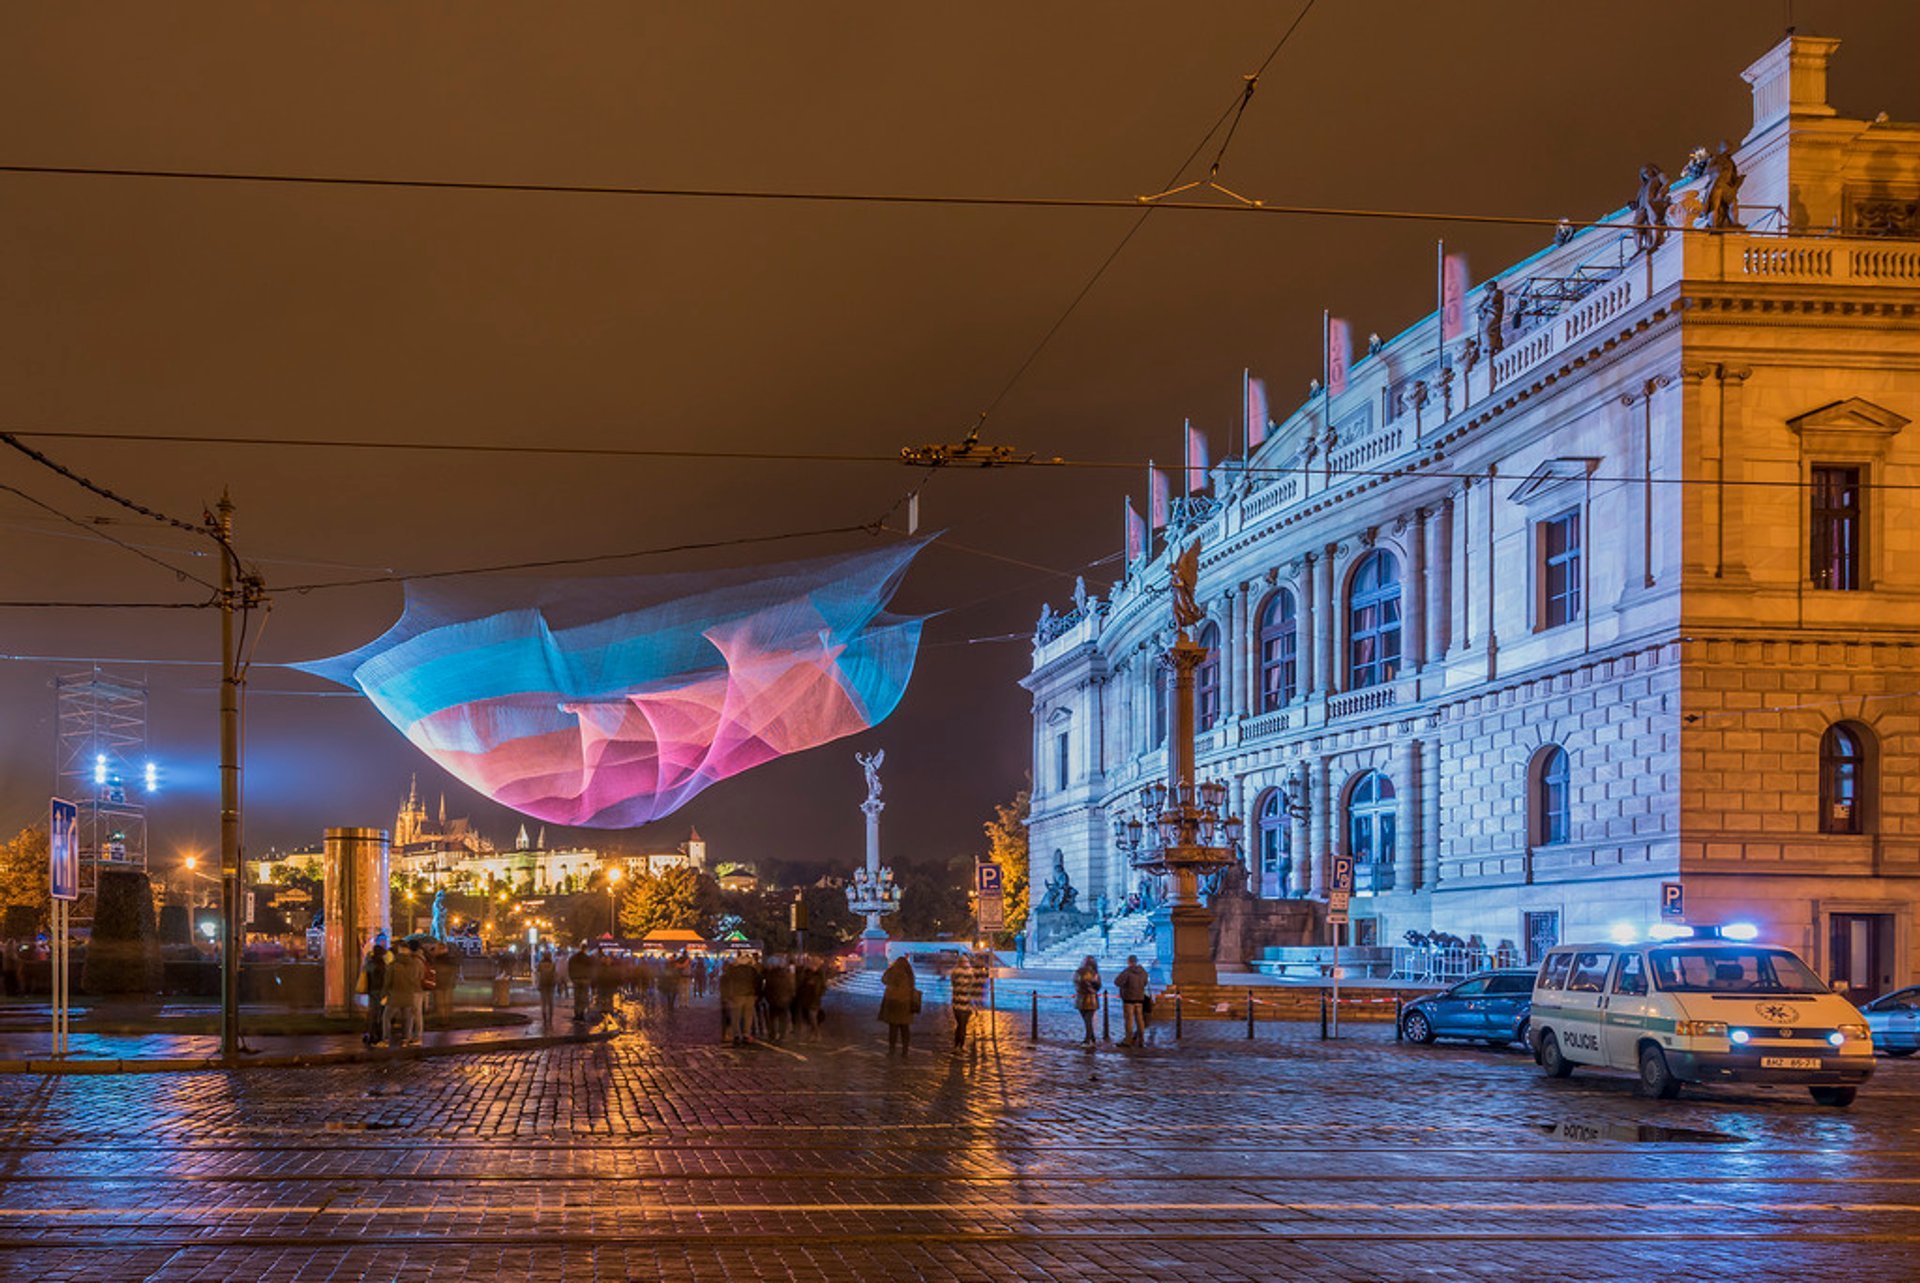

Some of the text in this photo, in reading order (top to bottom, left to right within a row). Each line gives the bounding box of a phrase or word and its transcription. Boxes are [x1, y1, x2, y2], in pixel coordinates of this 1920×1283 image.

[981, 868, 997, 889] P
[1337, 861, 1349, 880] P
[1667, 887, 1680, 906] P
[1563, 1031, 1599, 1051] POLICIE
